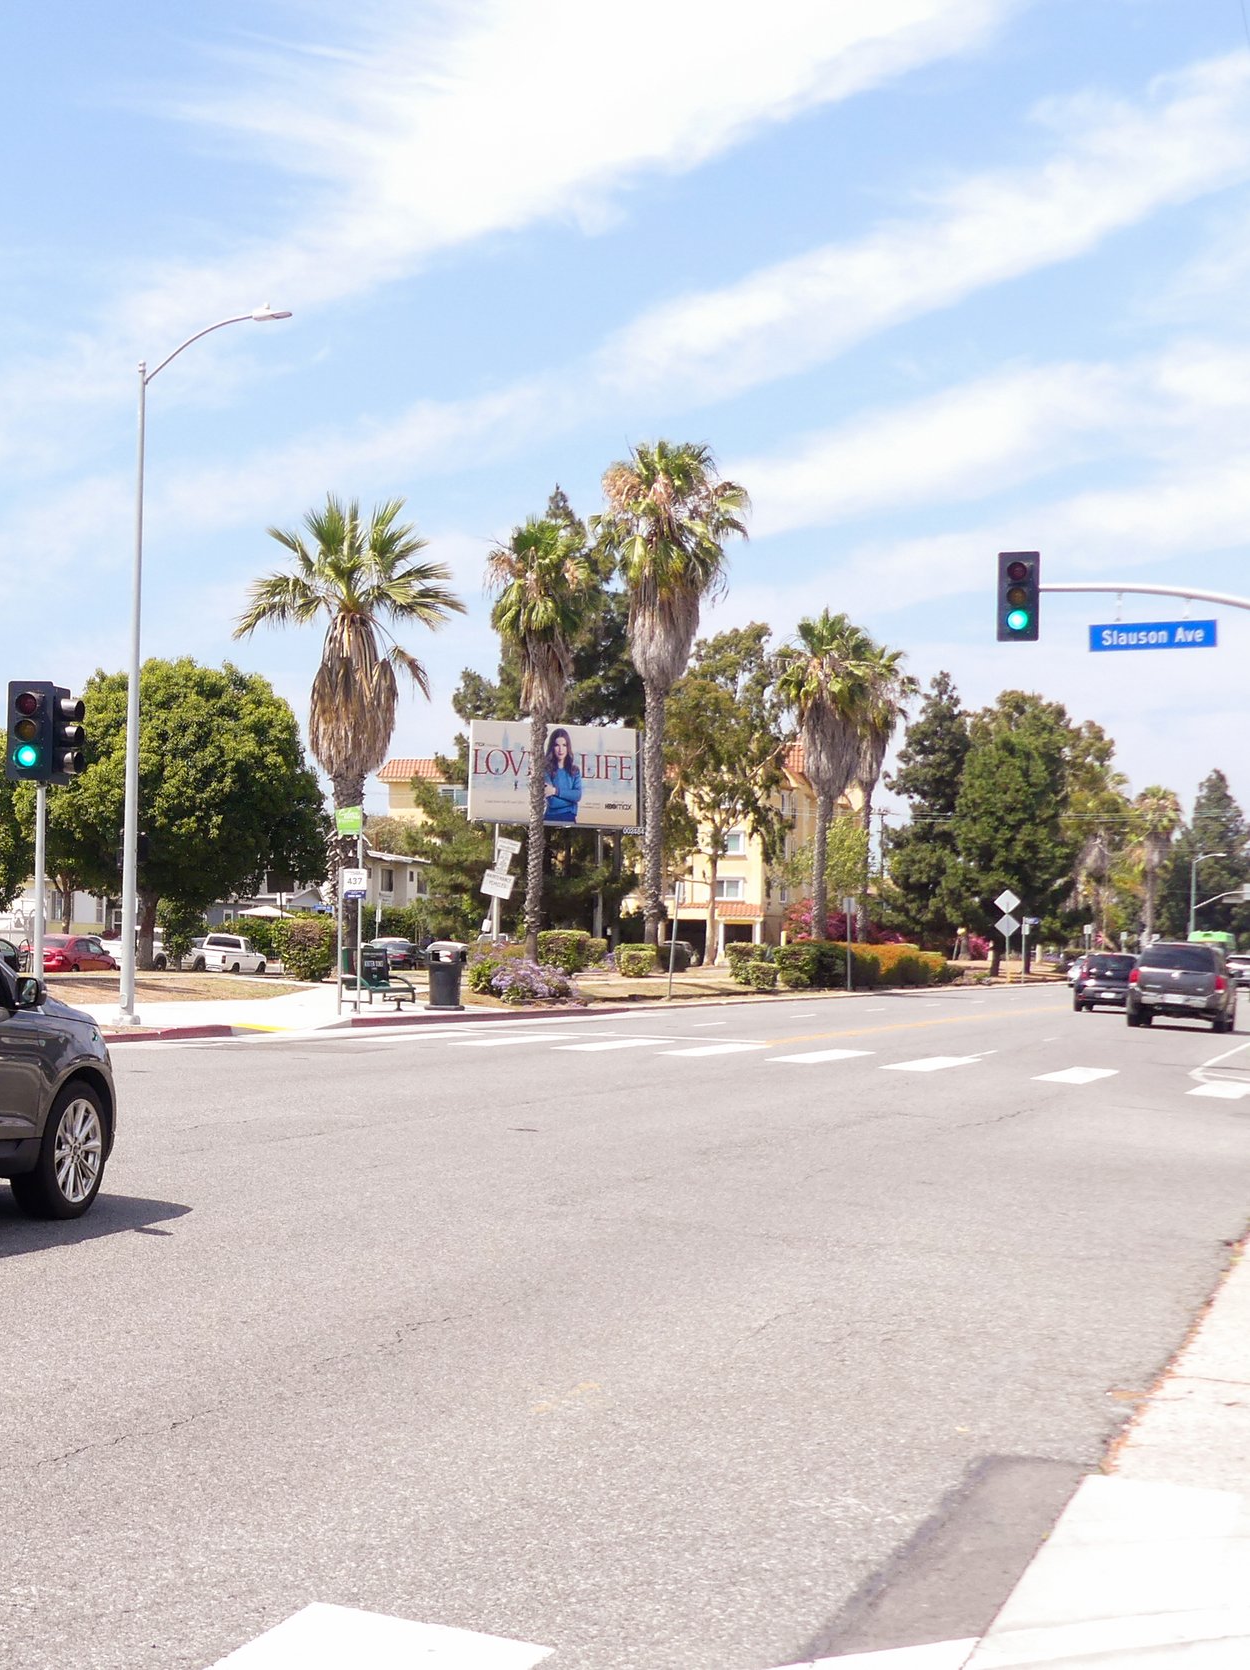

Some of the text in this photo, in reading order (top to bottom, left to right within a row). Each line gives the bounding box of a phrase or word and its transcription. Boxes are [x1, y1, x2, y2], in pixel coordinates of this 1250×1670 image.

[1101, 625, 1205, 646] Slauson Ave
[472, 748, 634, 781] LOV LIFE
[347, 877, 363, 885] 437
